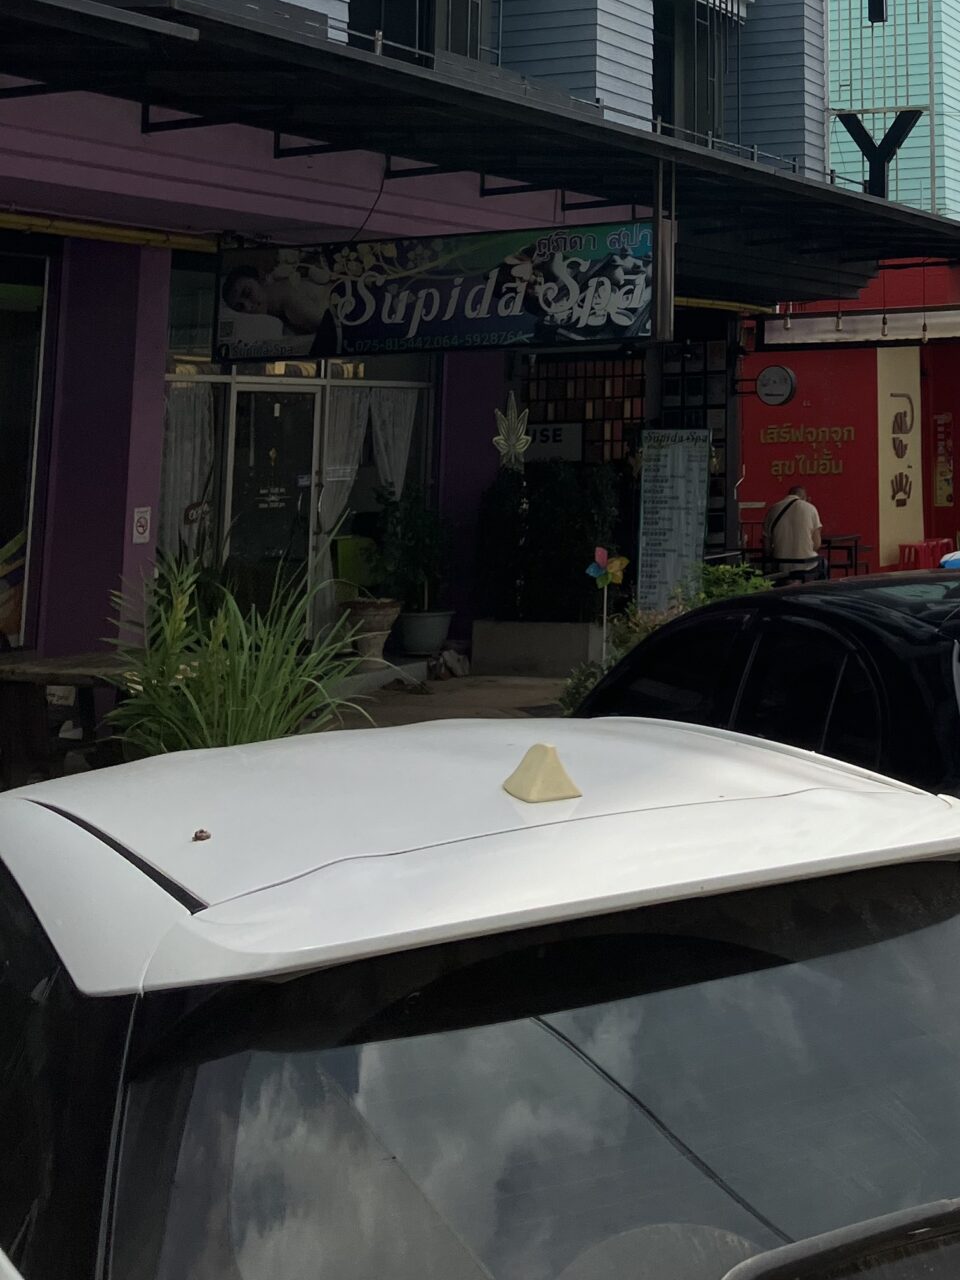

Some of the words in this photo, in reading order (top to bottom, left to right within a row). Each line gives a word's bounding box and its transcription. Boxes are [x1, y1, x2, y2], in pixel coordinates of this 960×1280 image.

[607, 223, 653, 249] สปา
[330, 267, 529, 339] Supida
[538, 252, 647, 328] Spa
[760, 423, 855, 448] เสิร์ฟจุกจุก
[770, 449, 843, 482] สุขไม่อั้น
